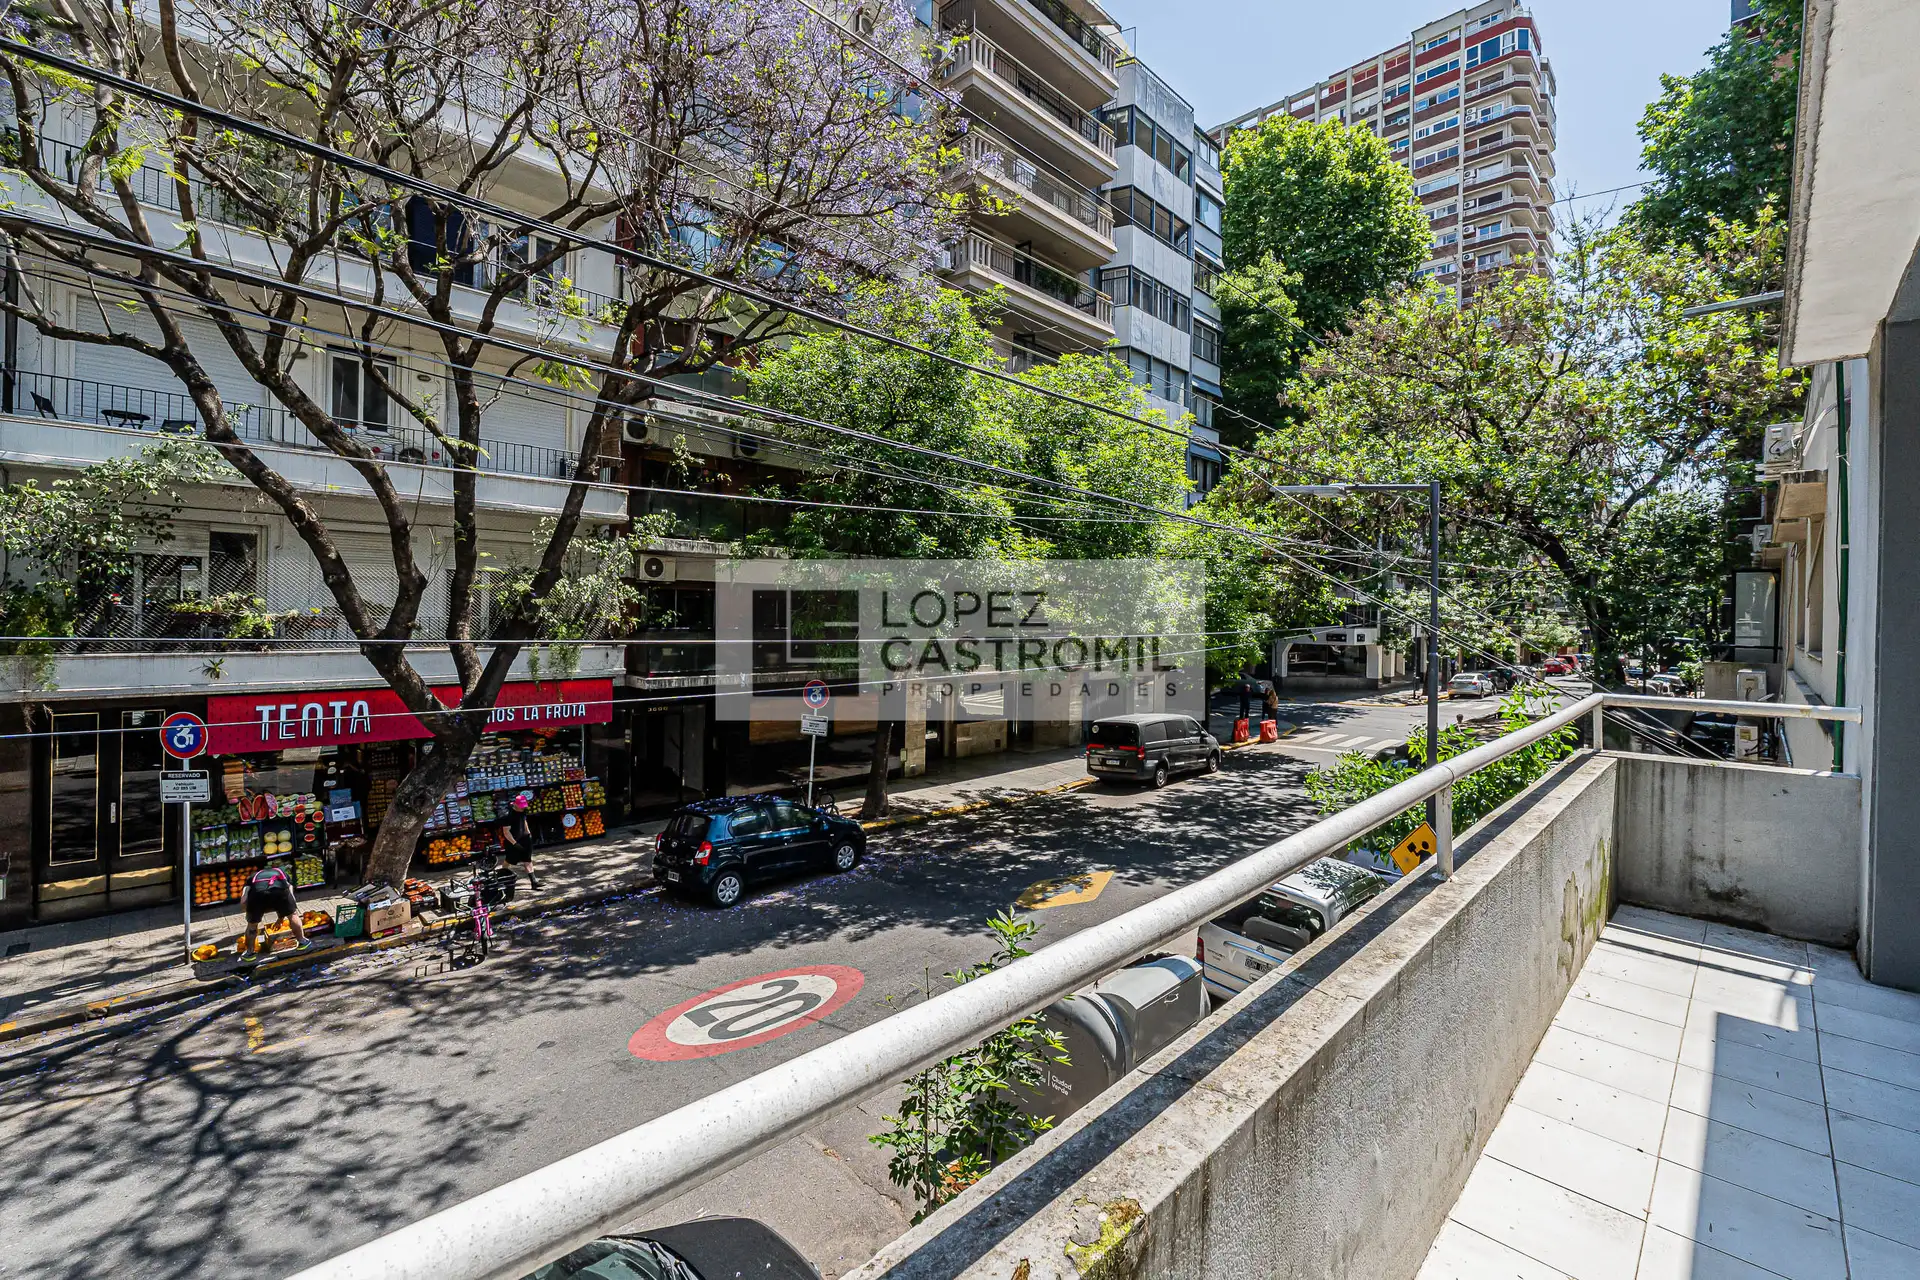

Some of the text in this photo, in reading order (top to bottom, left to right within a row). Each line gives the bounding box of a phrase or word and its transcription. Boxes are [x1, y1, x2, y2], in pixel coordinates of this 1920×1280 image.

[255, 700, 371, 741] TENTA
[523, 706, 539, 721] LA
[546, 703, 586, 719] FRUTA
[684, 979, 822, 1040] 20
[1051, 1075, 1072, 1090] Ciudad
[1051, 1081, 1069, 1096] Verde
